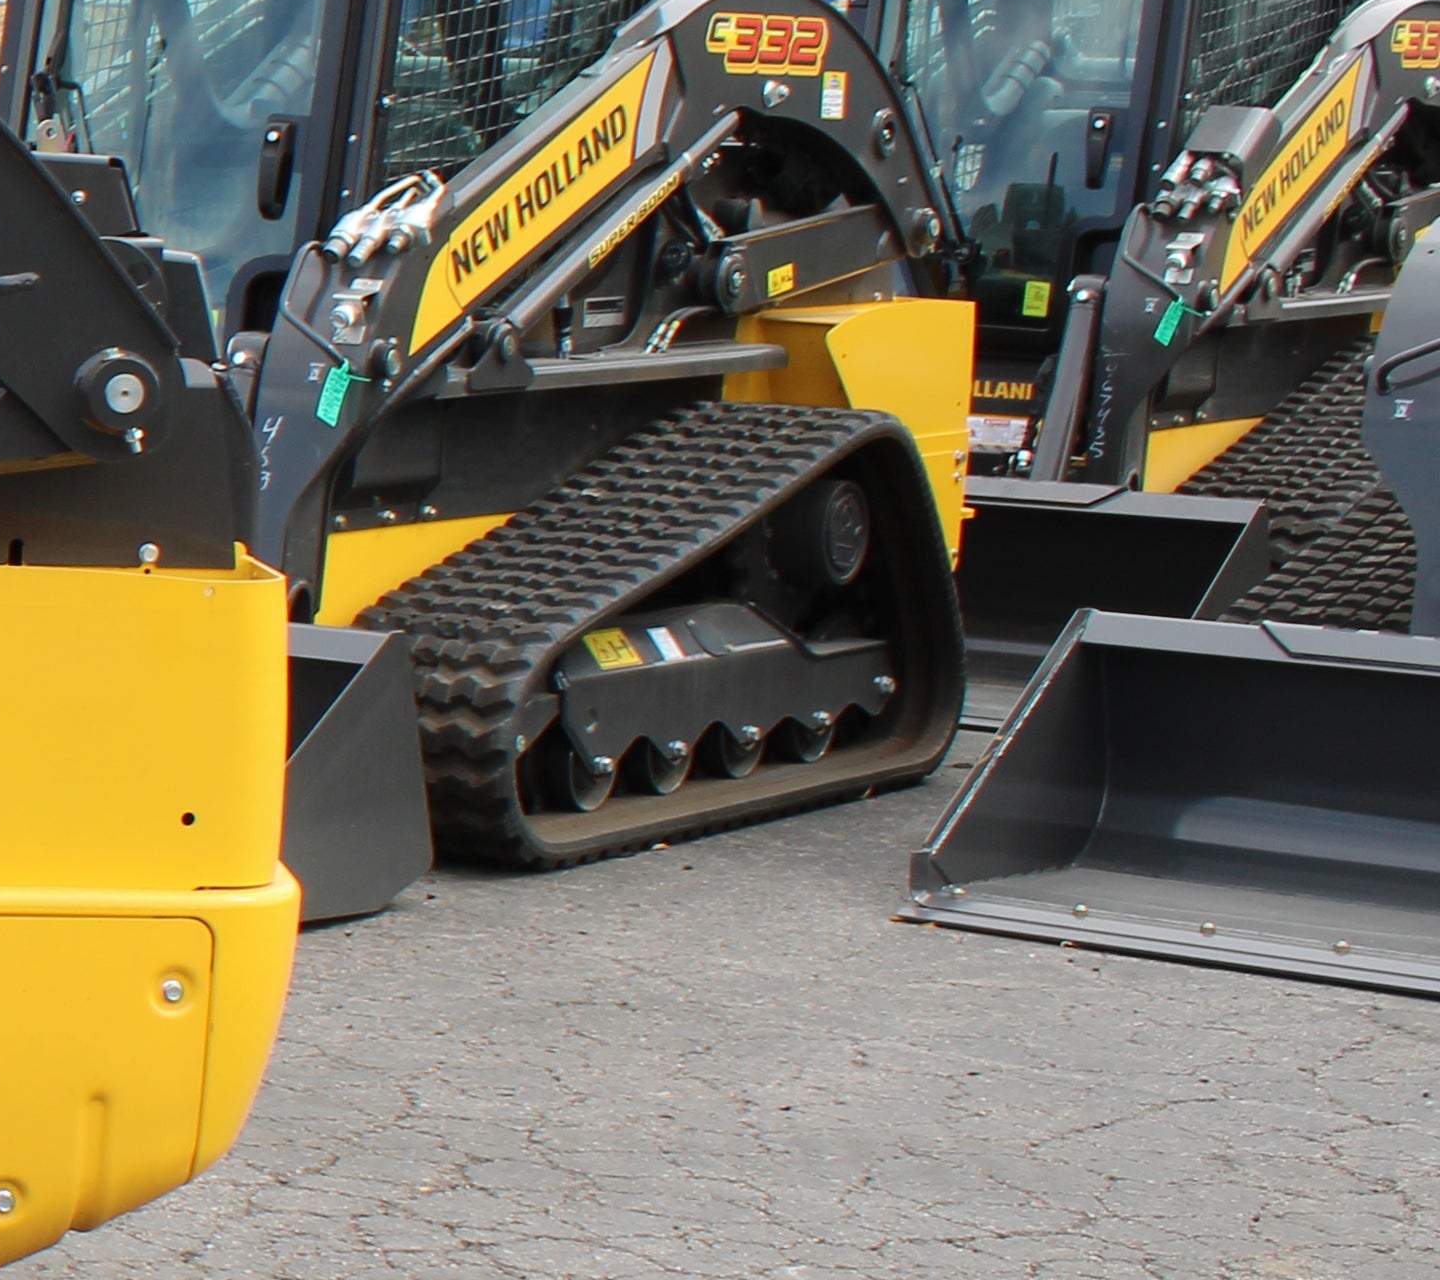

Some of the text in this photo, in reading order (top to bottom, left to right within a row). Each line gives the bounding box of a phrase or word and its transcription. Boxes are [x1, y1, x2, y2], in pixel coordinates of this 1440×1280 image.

[1391, 20, 1440, 68] C33
[451, 104, 628, 285] NEW HOLLAND
[1242, 98, 1345, 241] NEW HOLLAND
